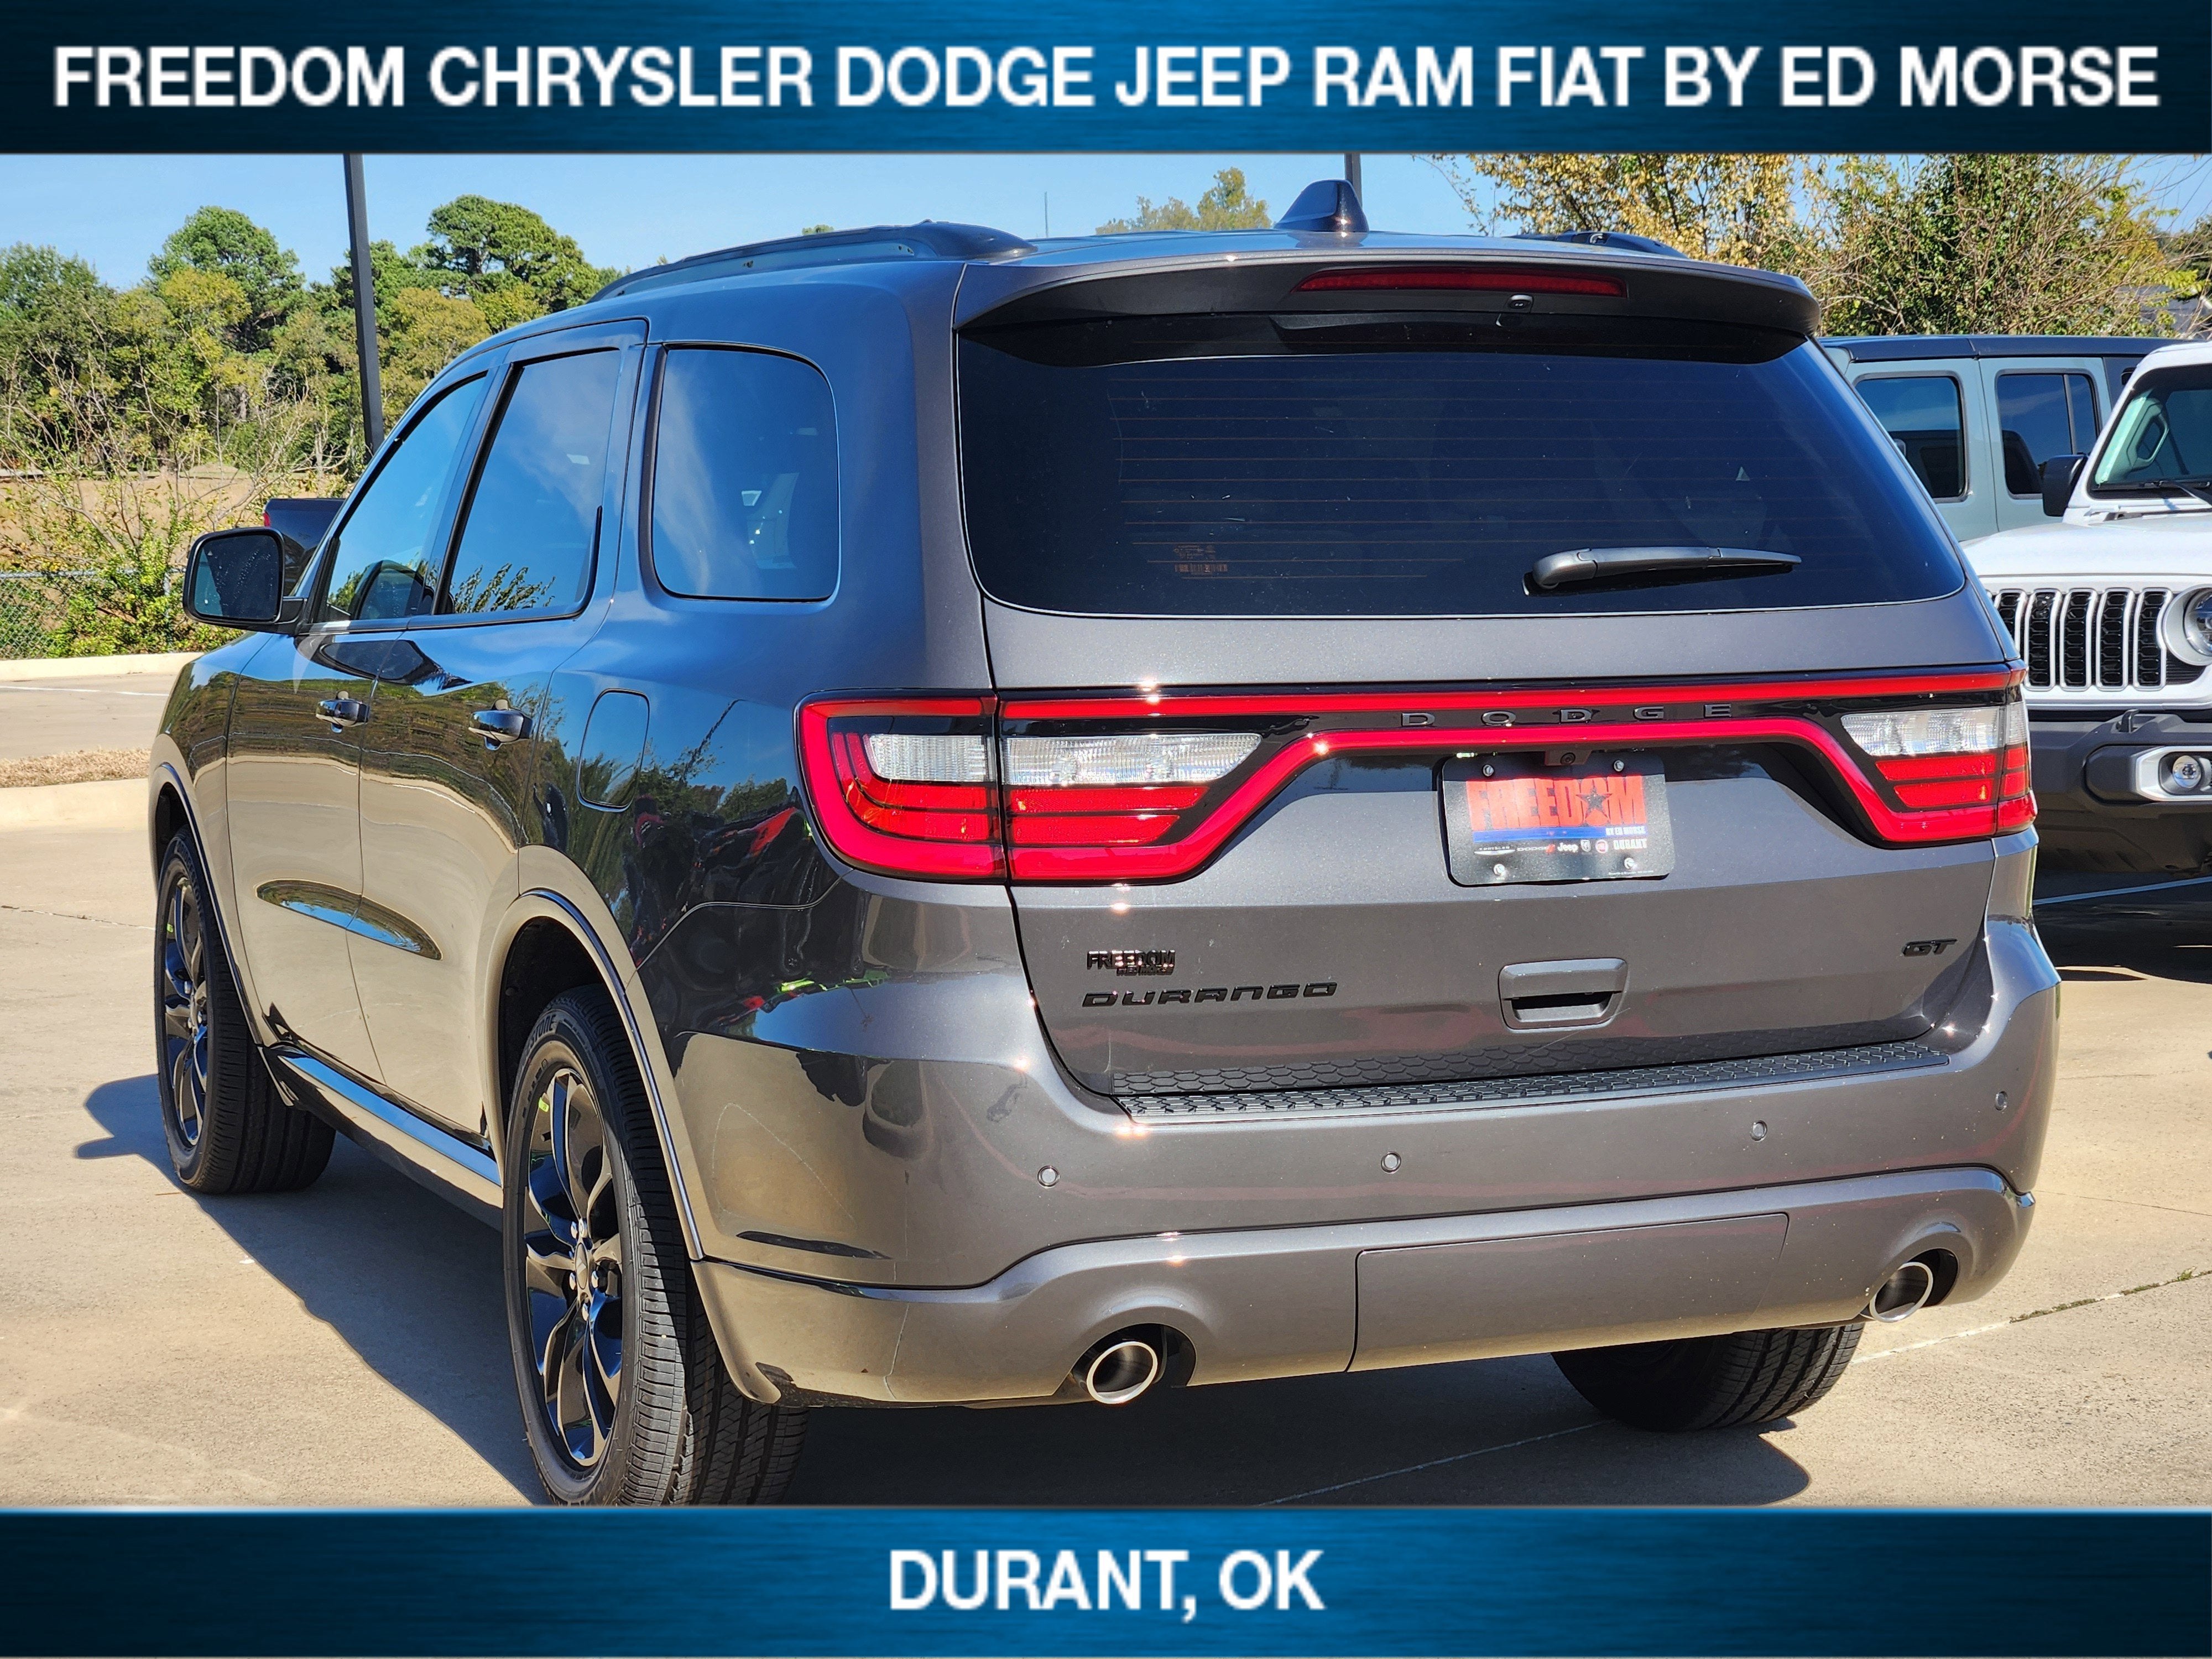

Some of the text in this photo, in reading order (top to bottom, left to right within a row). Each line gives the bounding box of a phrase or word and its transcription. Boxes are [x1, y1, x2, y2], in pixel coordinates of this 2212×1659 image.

[1400, 703, 1732, 728] DODGE
[1466, 774, 1646, 831] FREEDOM
[1557, 842, 1578, 853] Jeep
[1902, 938, 1957, 957] GT
[1087, 950, 1175, 969] FREEDOM
[1082, 982, 1338, 1008] DURANGO
